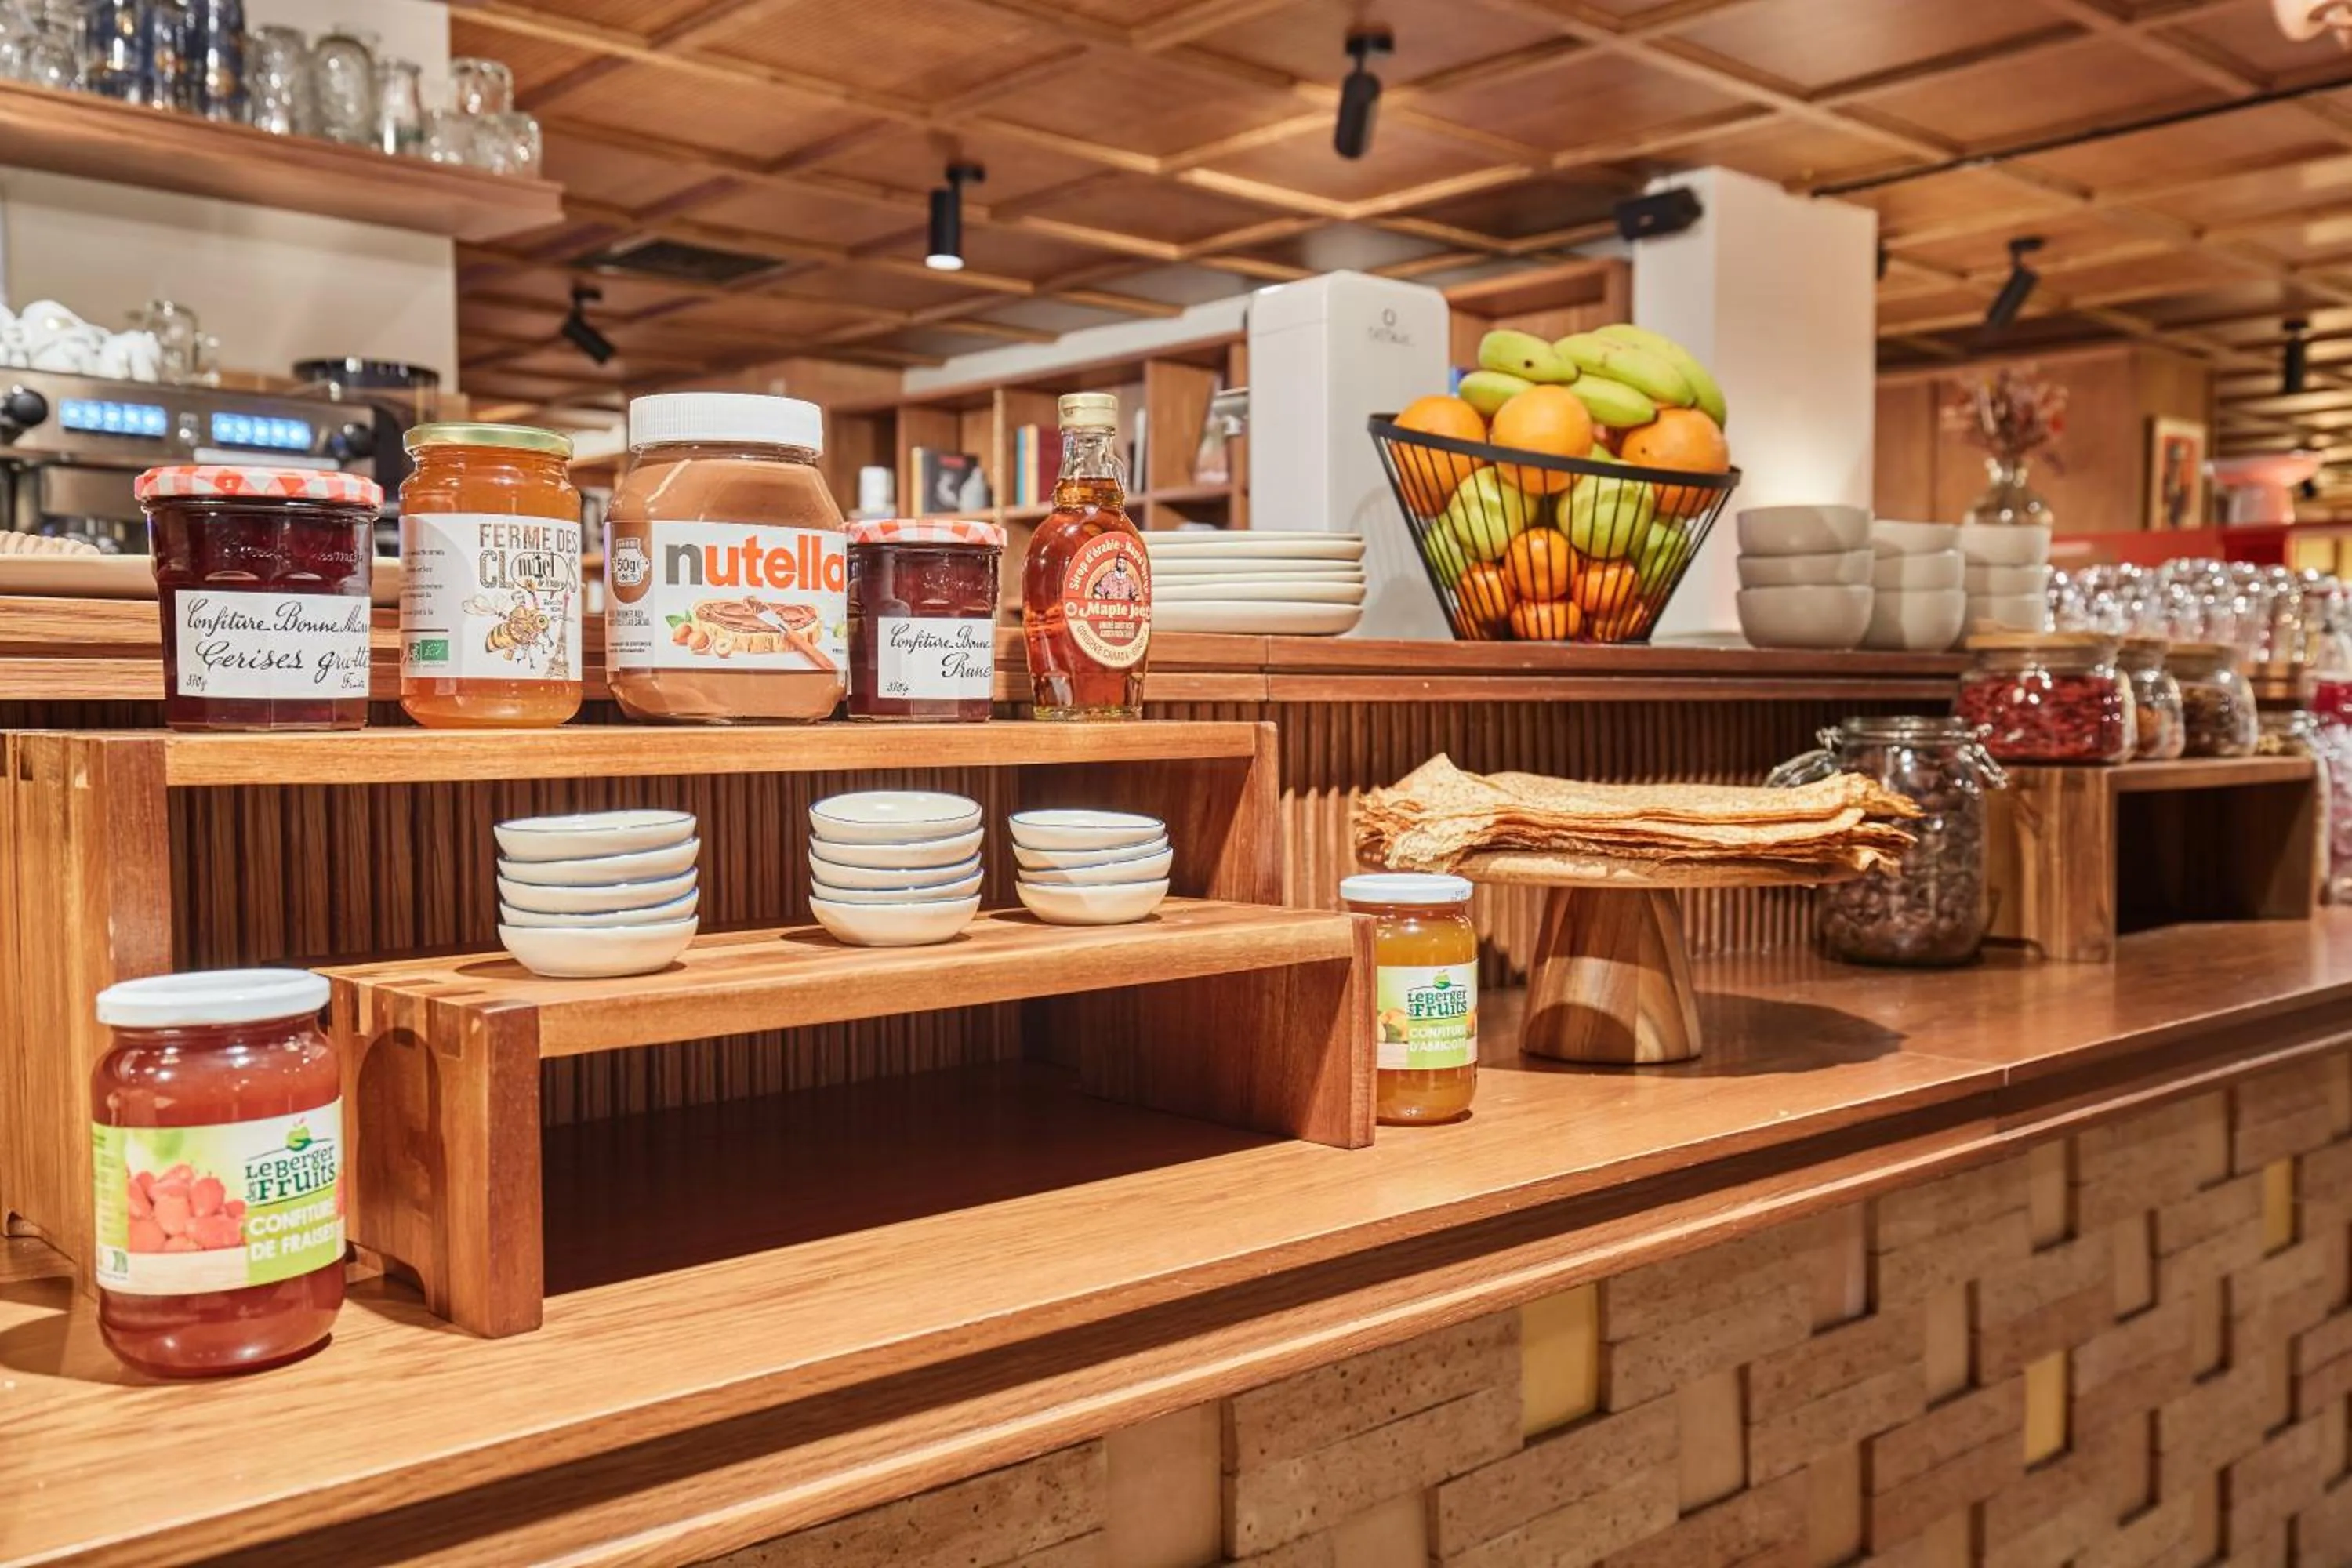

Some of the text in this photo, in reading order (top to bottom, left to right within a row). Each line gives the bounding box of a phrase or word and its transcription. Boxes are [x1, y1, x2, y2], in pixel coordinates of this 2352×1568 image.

[480, 523, 578, 554] FERME DES
[480, 550, 578, 593] CLS
[666, 534, 844, 593] nutella
[1069, 561, 1088, 590] Sirop
[187, 598, 270, 637] Confiture
[275, 601, 339, 631] Bonne
[1079, 601, 1128, 618] Maple
[891, 623, 953, 655] Confiture
[196, 641, 304, 672] Cerises
[1414, 1000, 1467, 1017] Fruits
[258, 1161, 336, 1200] Fruits
[249, 1240, 276, 1261] DE
